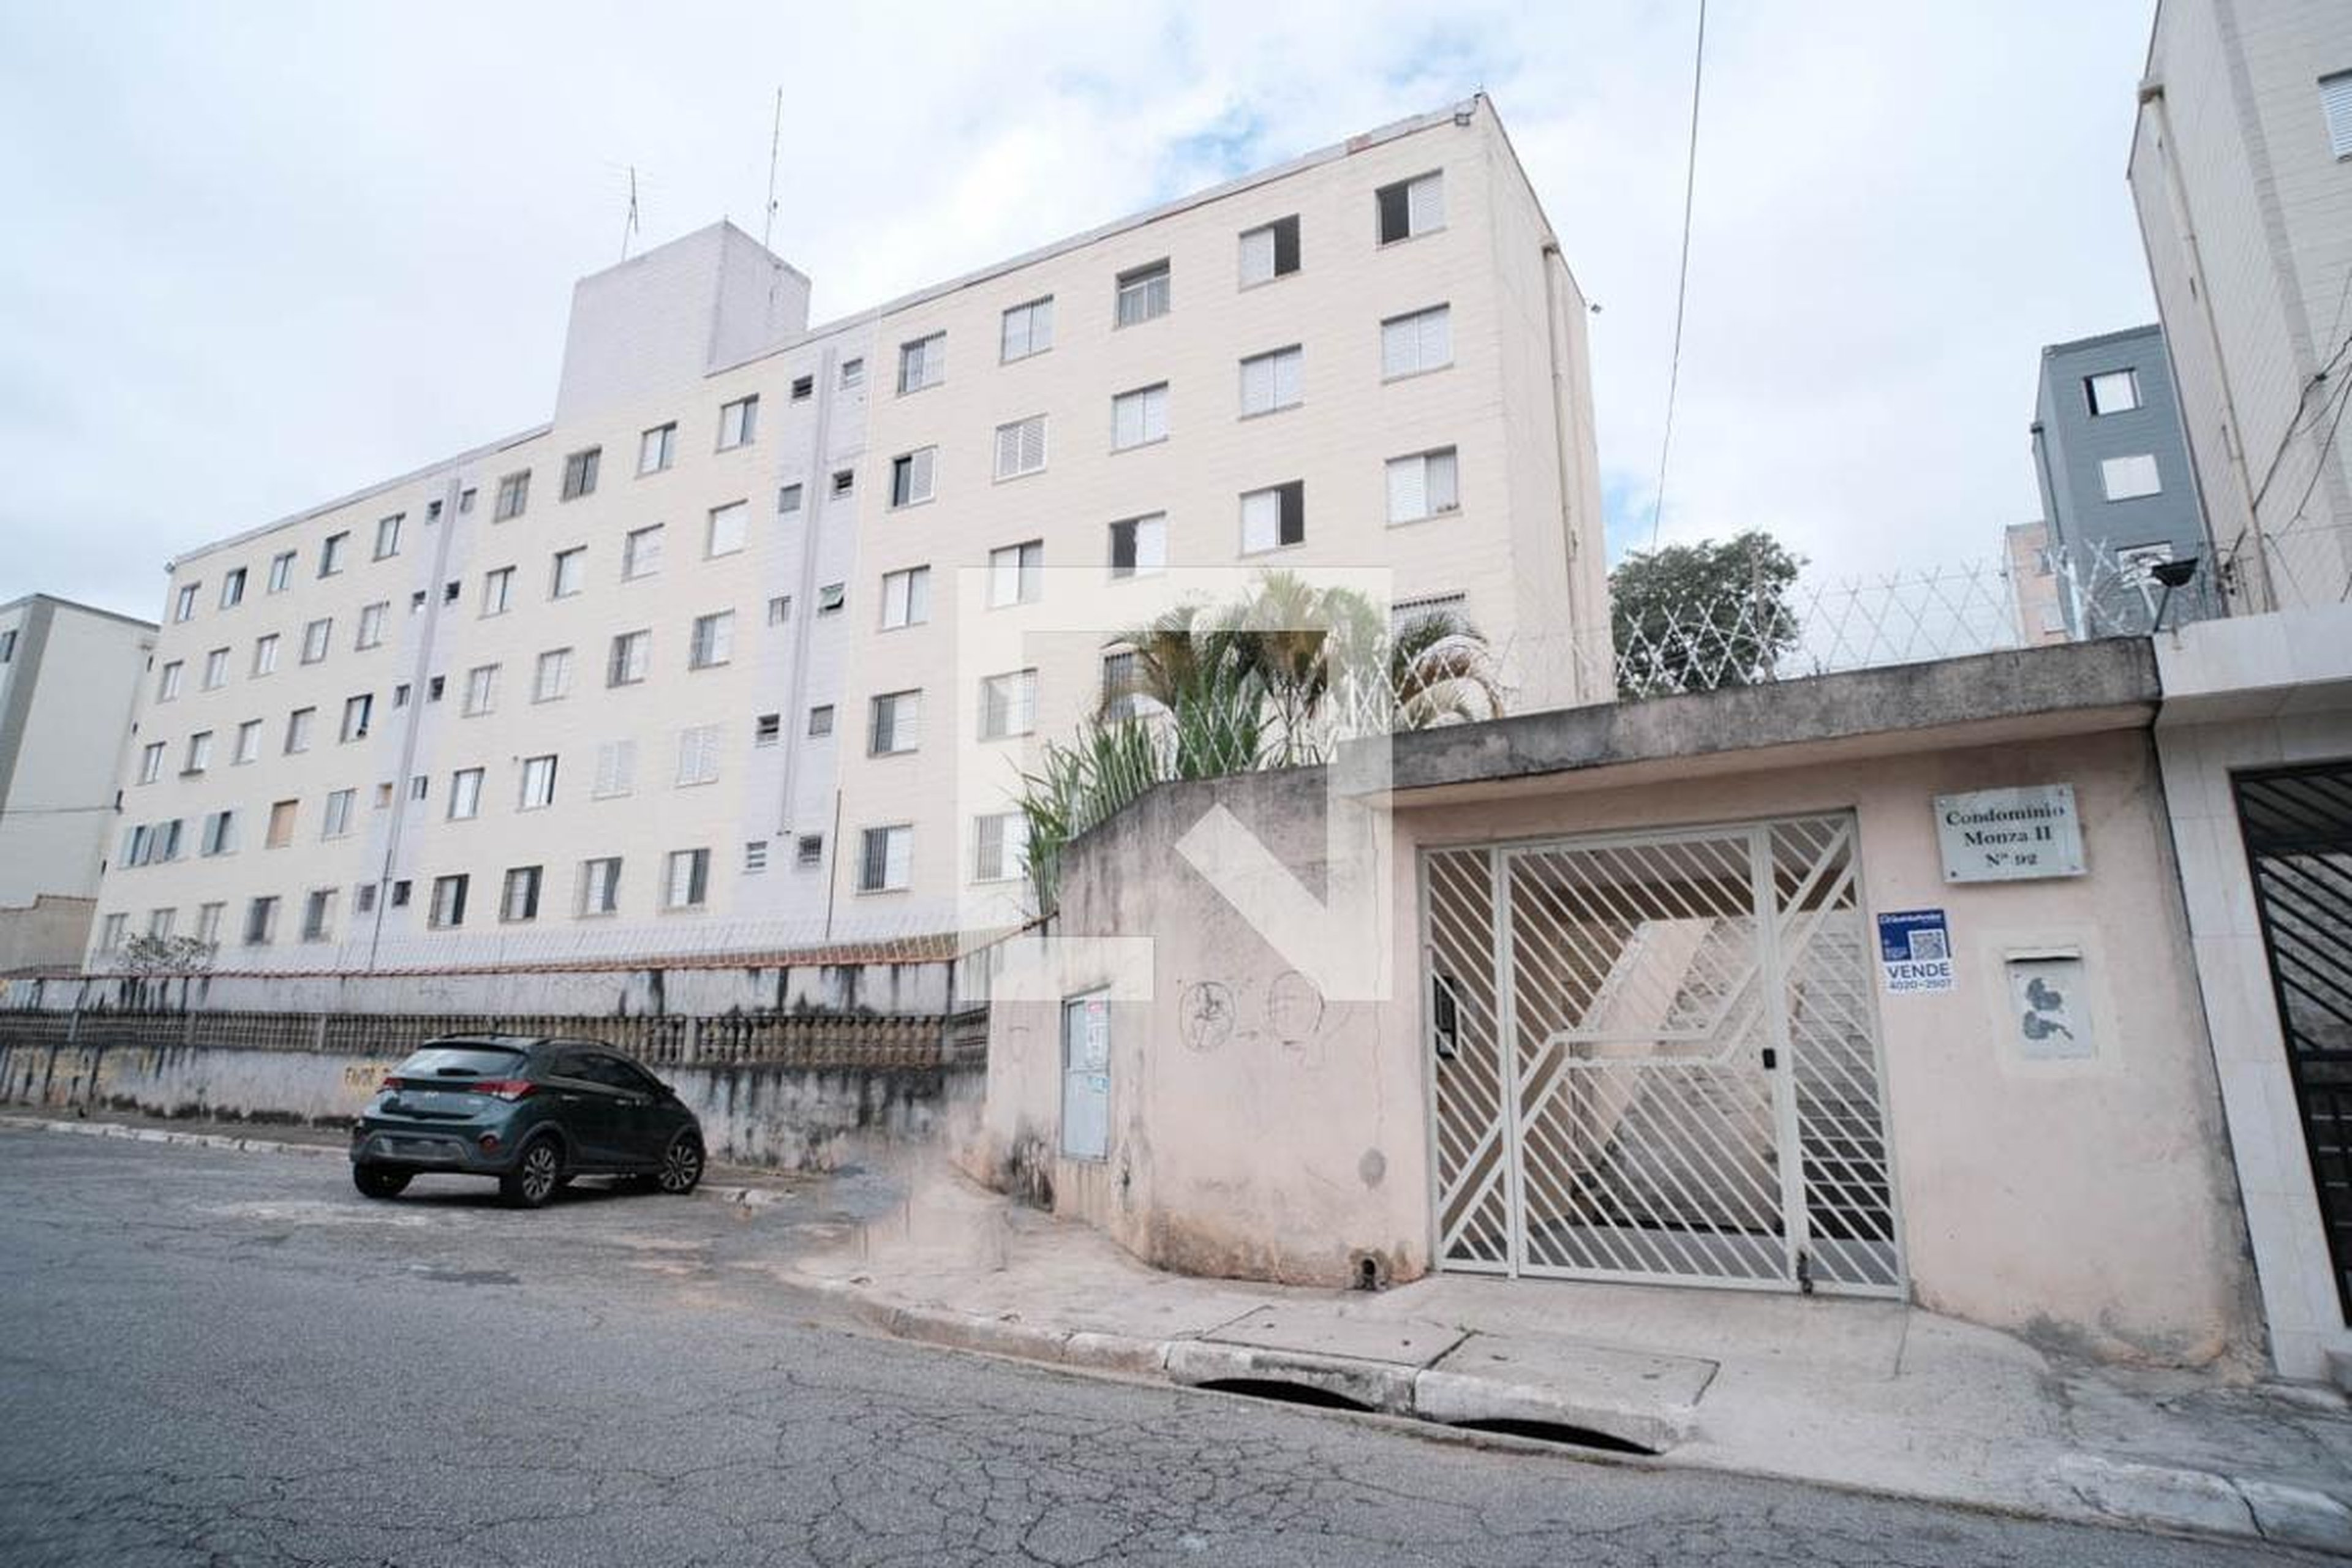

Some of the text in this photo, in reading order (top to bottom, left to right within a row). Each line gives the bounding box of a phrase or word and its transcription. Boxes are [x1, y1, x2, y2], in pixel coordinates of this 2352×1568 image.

[1964, 826, 2051, 846] Monza II
[1888, 962, 1950, 979] VENDE
